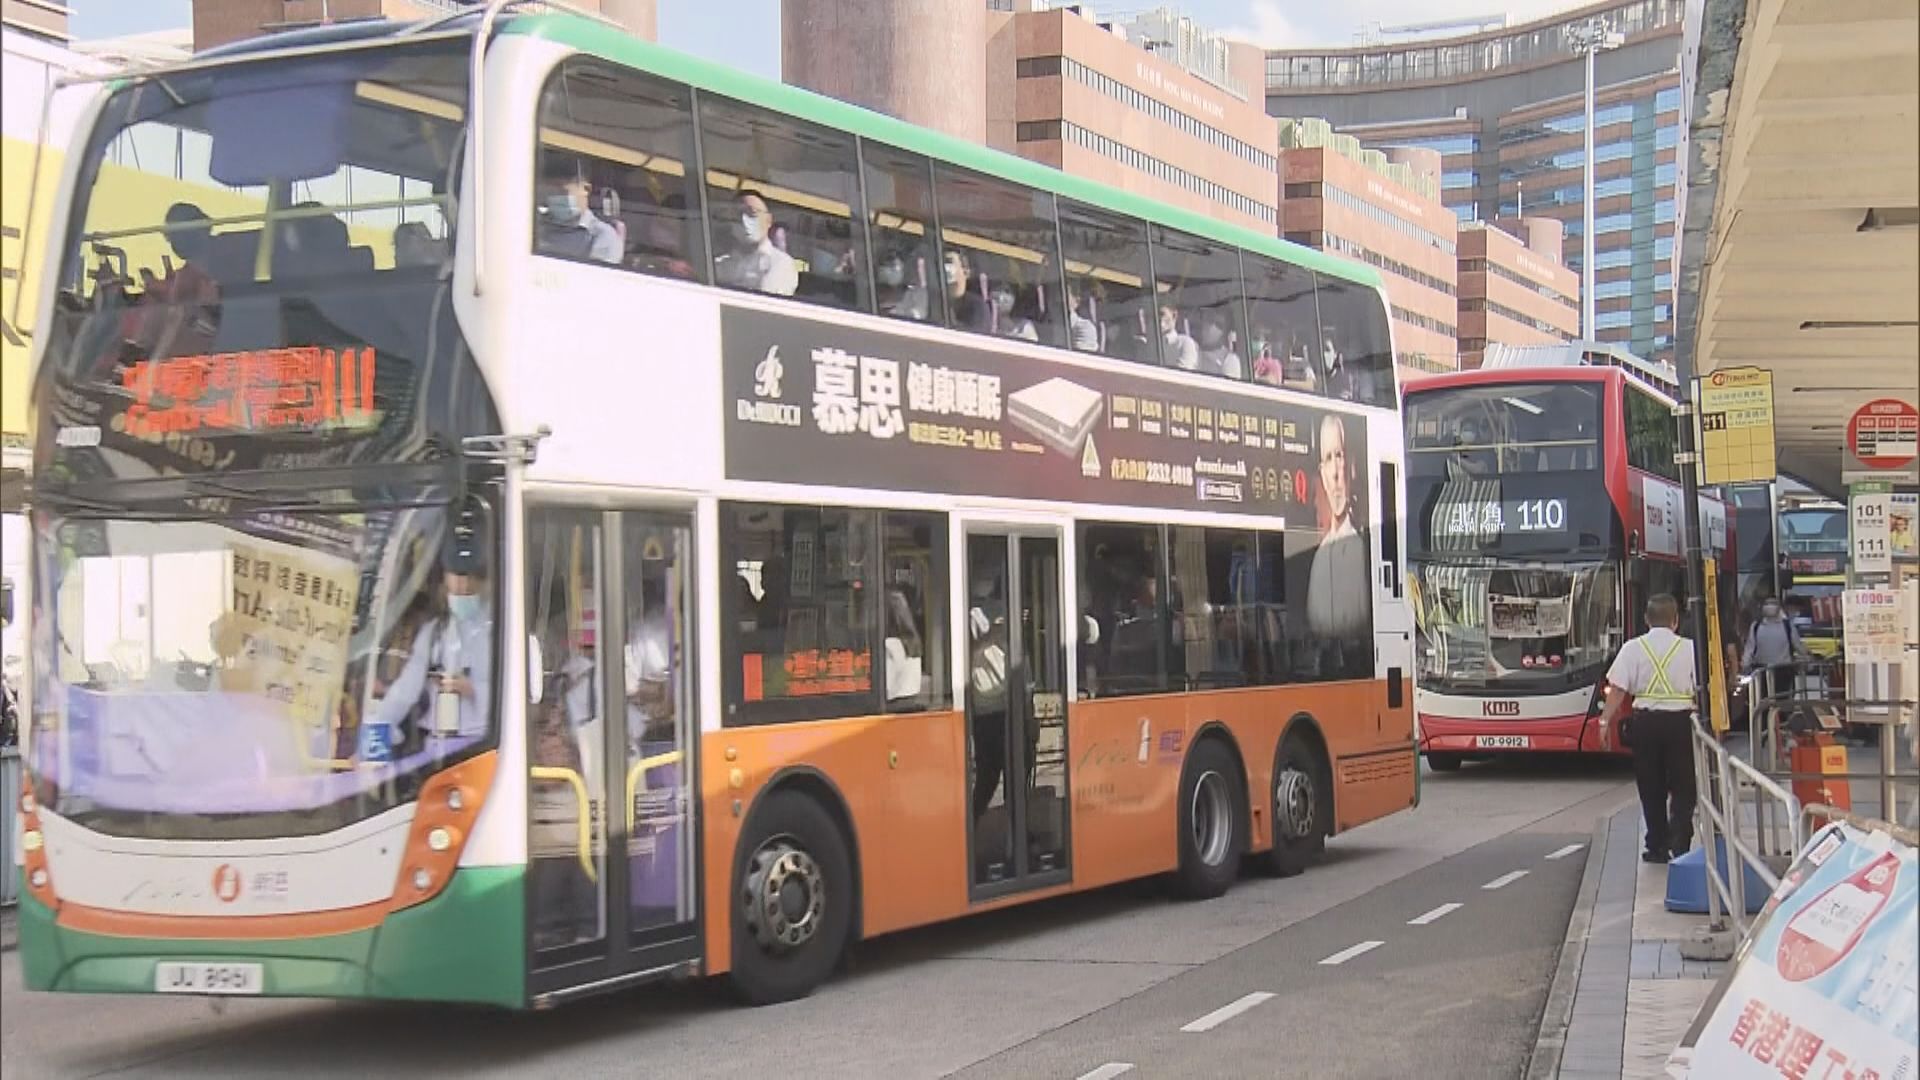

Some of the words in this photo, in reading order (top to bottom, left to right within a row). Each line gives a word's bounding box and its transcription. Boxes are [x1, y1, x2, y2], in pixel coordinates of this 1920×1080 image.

[1517, 499, 1563, 530] 110
[1857, 504, 1883, 517] 101
[1858, 538, 1884, 551] 111
[1482, 701, 1520, 716] KMB
[1481, 736, 1496, 747] VD
[1498, 736, 1523, 747] 9912
[1728, 998, 1882, 1080] 香港理工
